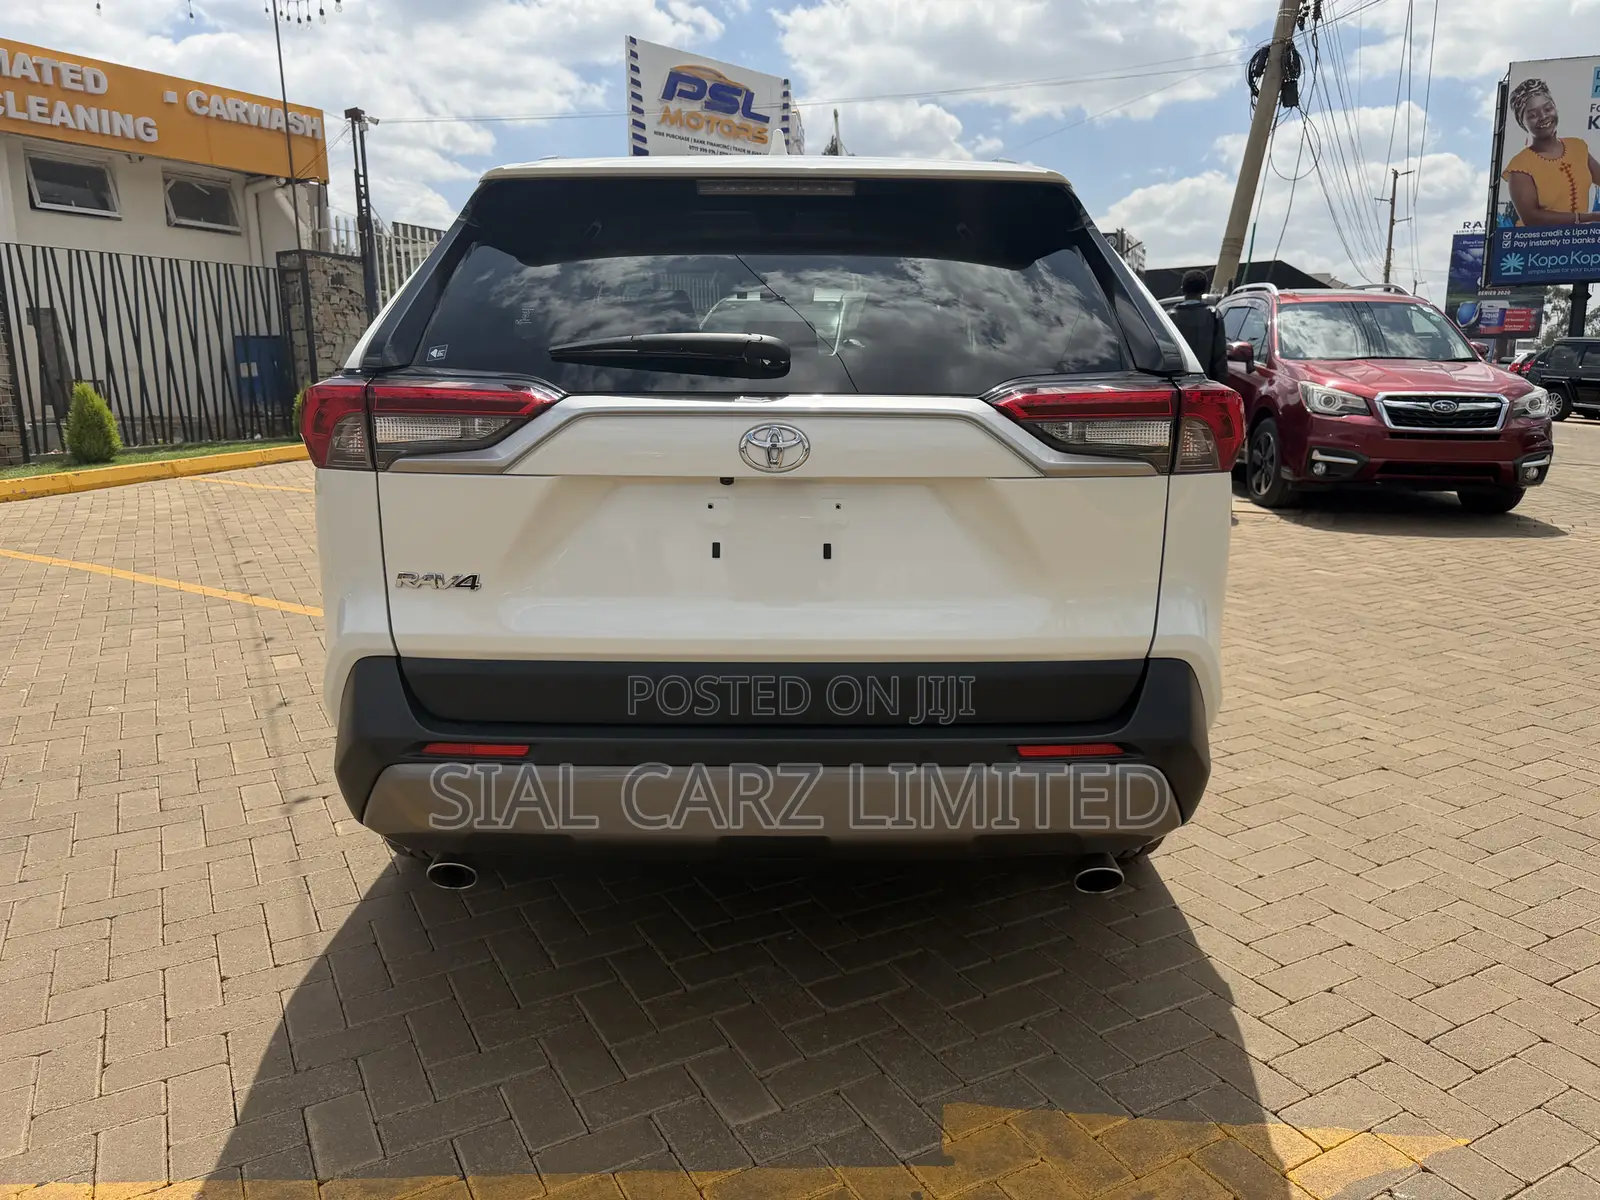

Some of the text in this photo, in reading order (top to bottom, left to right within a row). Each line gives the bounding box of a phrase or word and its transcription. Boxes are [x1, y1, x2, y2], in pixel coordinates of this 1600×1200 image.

[660, 69, 771, 124] PSL
[0, 90, 159, 142] LEANING
[186, 89, 323, 140] CARWASH
[659, 104, 769, 145] MOTORS
[665, 132, 690, 142] PURCHASE
[693, 138, 706, 146] BANK
[706, 140, 731, 151] FINANCING
[1463, 221, 1485, 229] RA
[1514, 231, 1540, 239] Access
[1541, 229, 1563, 237] credit
[1572, 228, 1588, 237] Lipa
[1513, 240, 1528, 249] Pay
[1529, 239, 1561, 247] instantly
[1571, 236, 1596, 244] banks
[395, 571, 482, 592] RAV4
